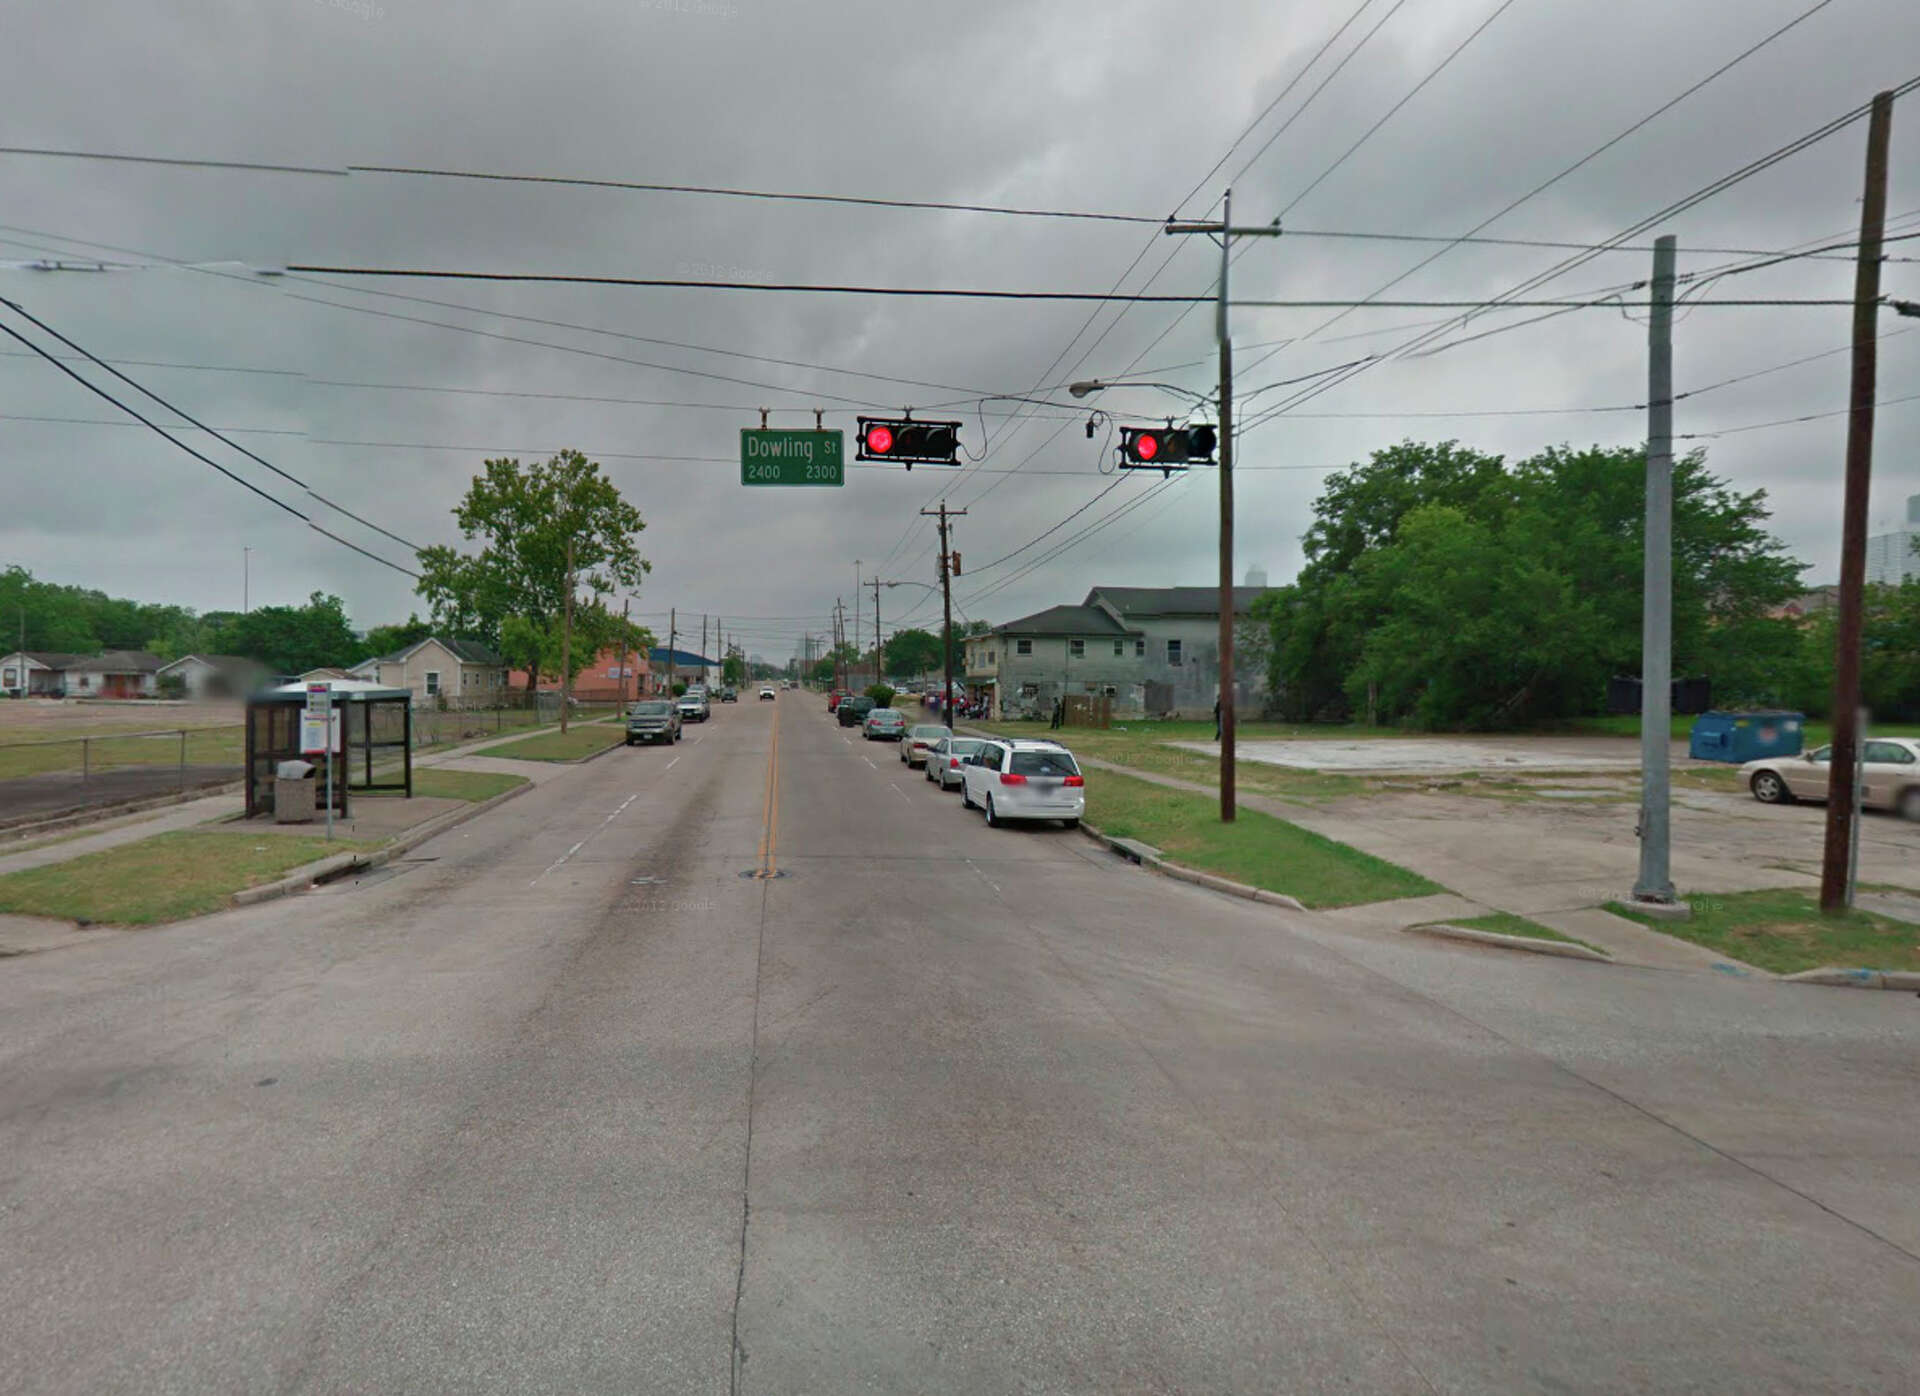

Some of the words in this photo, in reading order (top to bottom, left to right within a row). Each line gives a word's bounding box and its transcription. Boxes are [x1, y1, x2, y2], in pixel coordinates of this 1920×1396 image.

[748, 436, 813, 463] Dowling
[824, 441, 836, 454] St
[748, 465, 780, 479] 2400
[806, 465, 837, 479] 2300
